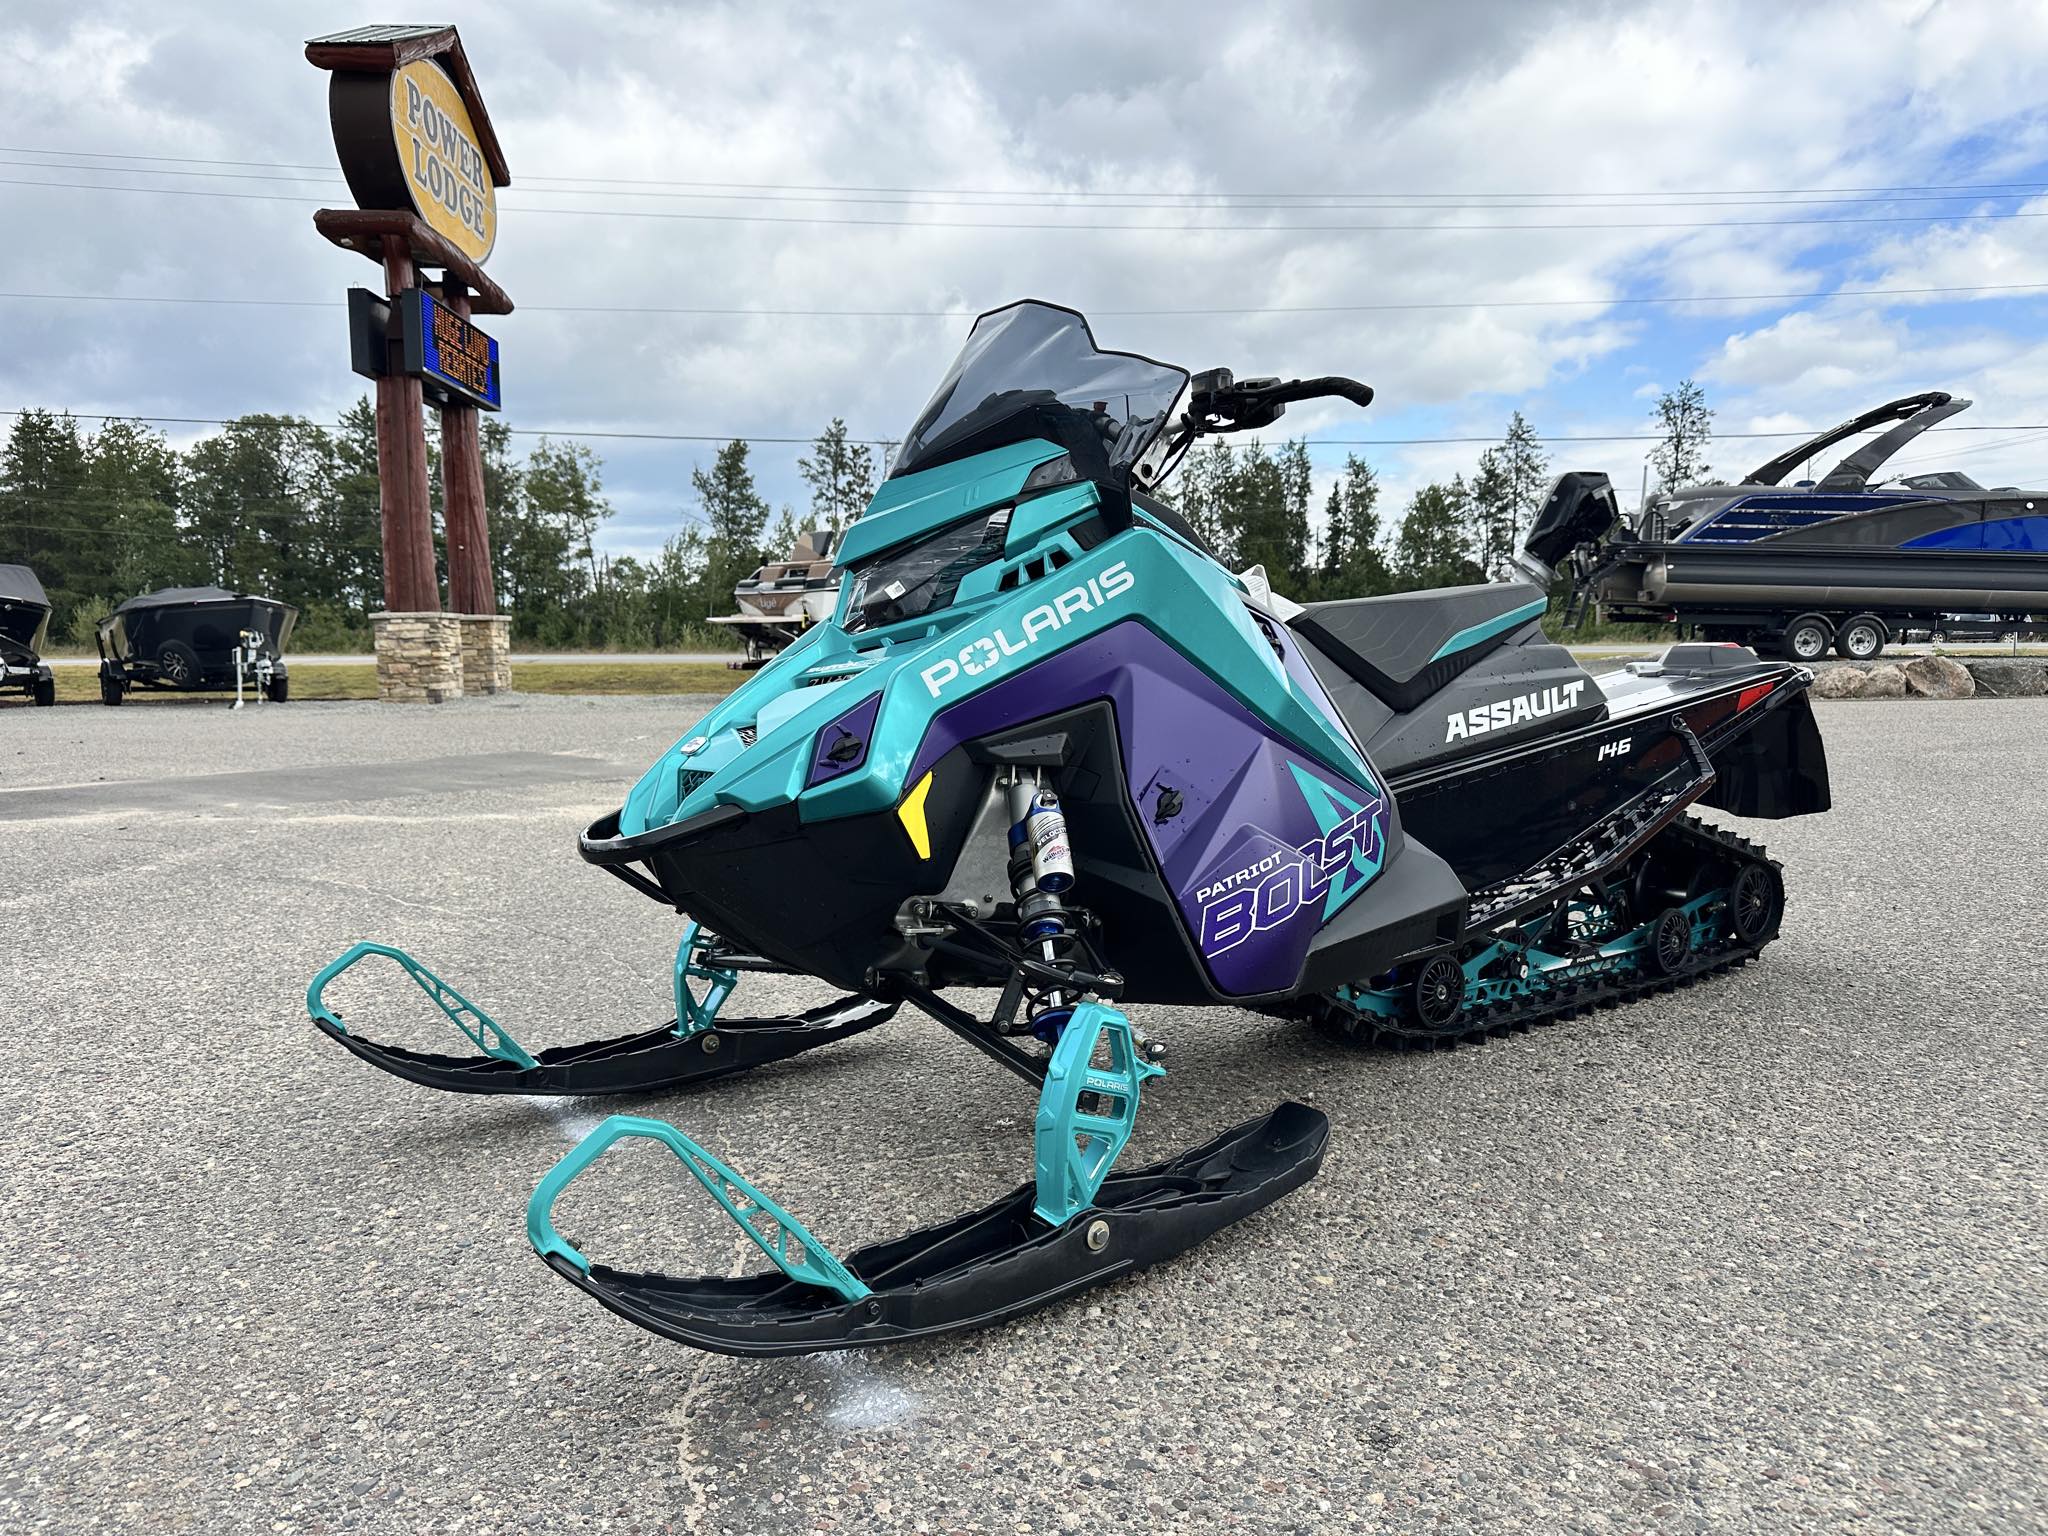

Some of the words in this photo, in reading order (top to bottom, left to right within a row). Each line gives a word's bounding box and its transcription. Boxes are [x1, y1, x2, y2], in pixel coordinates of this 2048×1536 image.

[406, 77, 486, 195] POWER
[412, 137, 486, 239] LODGE
[919, 560, 1135, 699] POLARIS
[1445, 679, 1585, 744] ASSAULT
[1597, 737, 1632, 762] 146
[1196, 850, 1282, 903] PATRIOT
[1200, 799, 1383, 959] BOOST
[1086, 1076, 1129, 1092] POLARIS
[808, 1237, 851, 1284] POLARIS
